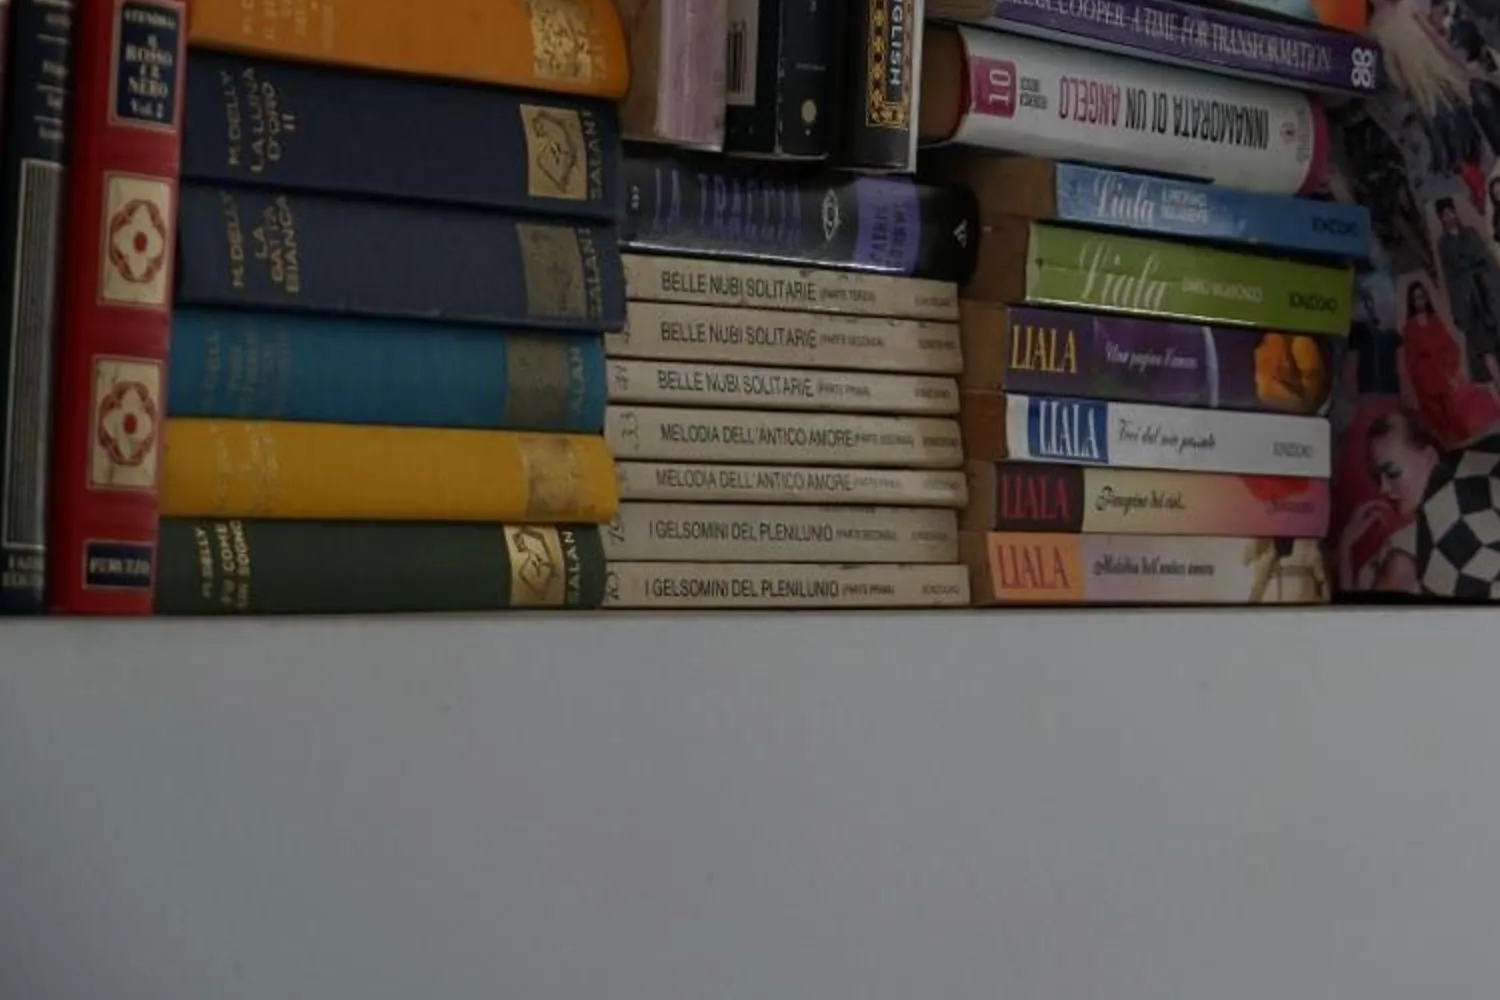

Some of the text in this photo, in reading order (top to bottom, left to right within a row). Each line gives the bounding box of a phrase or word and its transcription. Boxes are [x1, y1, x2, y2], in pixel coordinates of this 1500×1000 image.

[1210, 22, 1334, 73] TRANSFORMATION
[127, 76, 169, 98] NERO
[1058, 75, 1270, 151] INNAMORATA DI UN ANGELO
[1094, 174, 1156, 224] Liala
[275, 194, 300, 294] BIANCA
[660, 270, 817, 302] BELLE NUBI SOLITARIE
[1079, 237, 1171, 312] Liala
[660, 320, 817, 349] BELLE NUBI SOLITARIE
[1008, 323, 1078, 375] LIALA
[657, 369, 703, 392] BELLE
[705, 372, 741, 394] NUBI
[741, 373, 815, 398] SOLITARIE
[660, 422, 855, 450] MELODIA DELL'ANTICO AMORE
[1038, 400, 1100, 460] LIALA
[655, 467, 854, 492] MELODIA DELL'ANTICO AMORE
[1000, 470, 1071, 521] LIALA
[214, 522, 236, 573] COME
[230, 520, 250, 577] SOGNO
[648, 521, 654, 540] I
[656, 519, 730, 541] GELSOMINI
[731, 520, 758, 542] DEL
[759, 520, 834, 543] PLENILUNIO
[644, 579, 650, 597] I
[651, 578, 730, 600] GELSOMINI
[731, 579, 759, 600] DEL
[760, 579, 840, 601] PLENILUNIO
[997, 543, 1071, 590] LIALA
